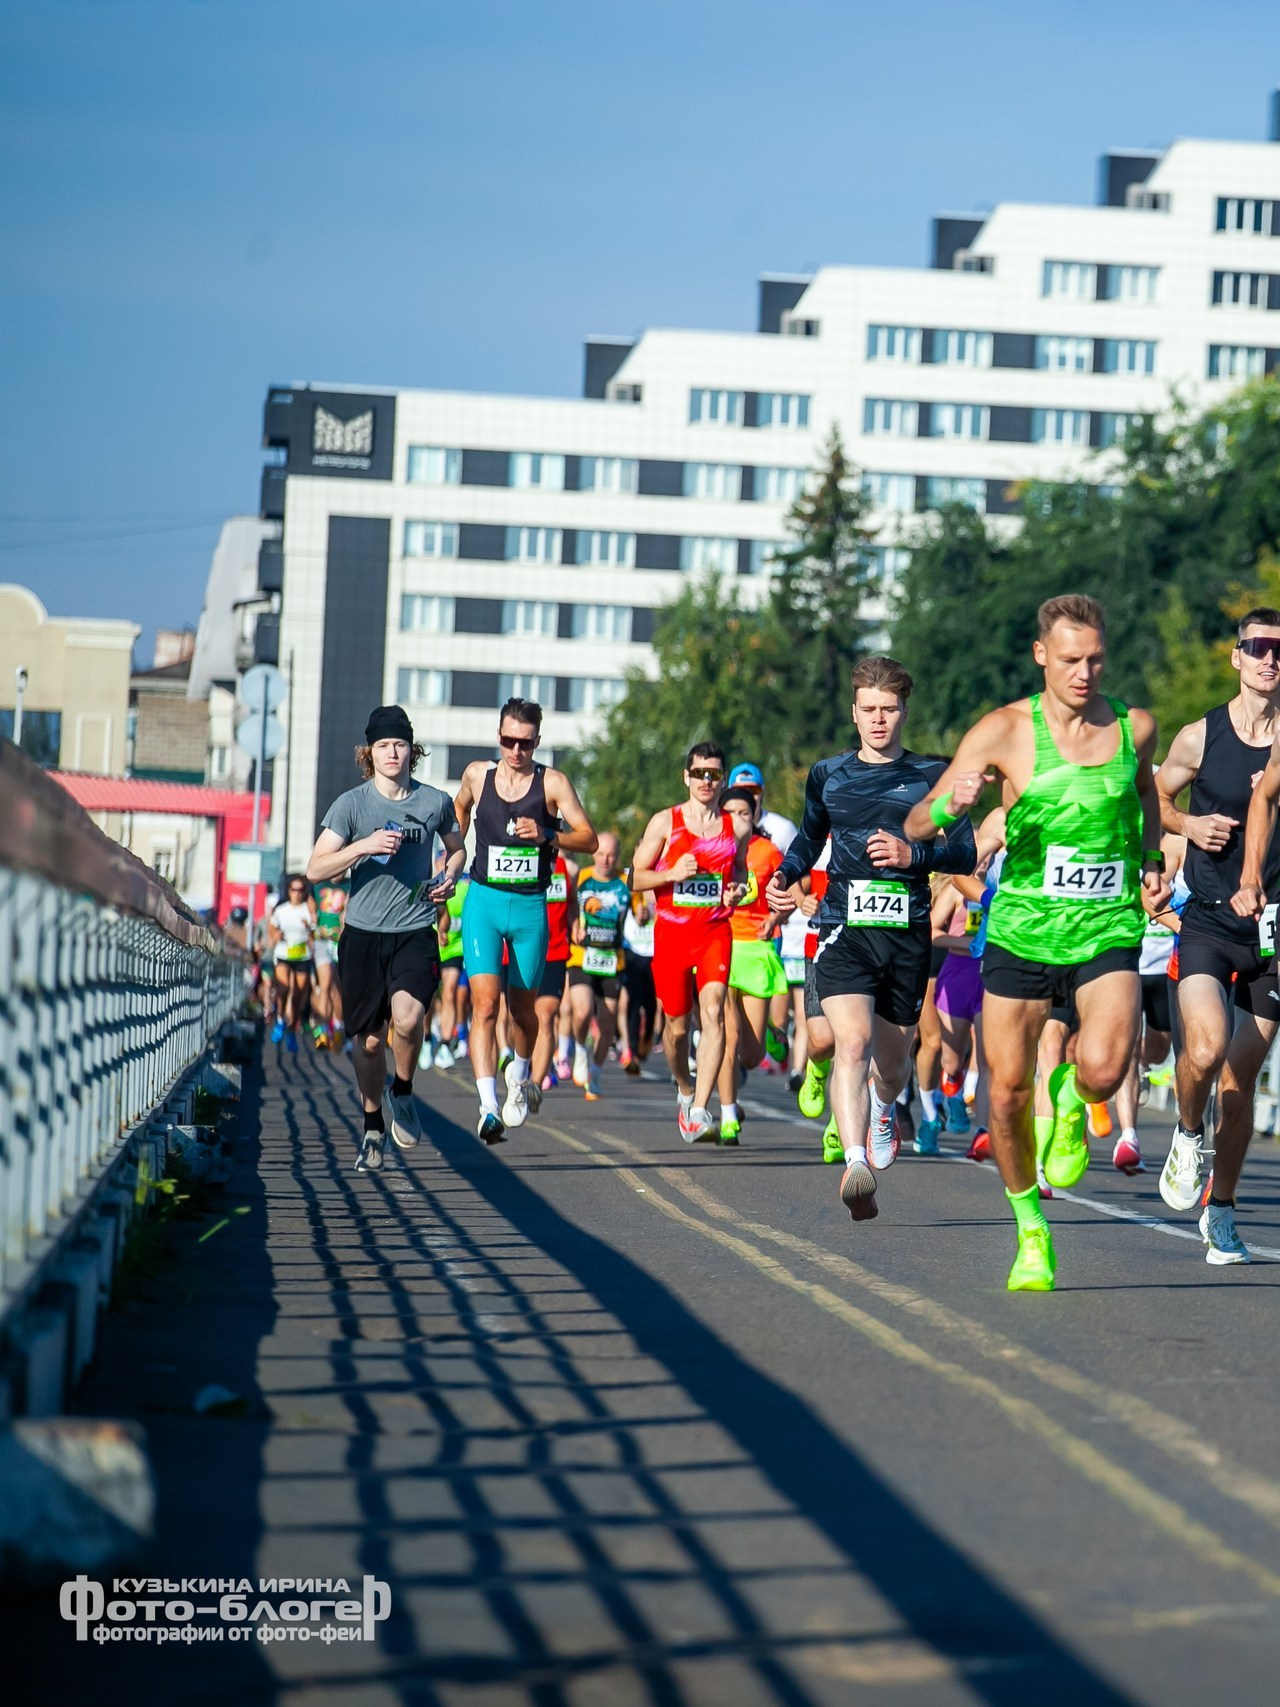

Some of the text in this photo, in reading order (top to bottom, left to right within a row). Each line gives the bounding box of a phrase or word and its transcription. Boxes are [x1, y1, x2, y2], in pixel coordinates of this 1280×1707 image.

[495, 858, 532, 872] 1271
[1053, 865, 1117, 889] 1472
[677, 882, 719, 897] 1498
[854, 895, 904, 915] 1474
